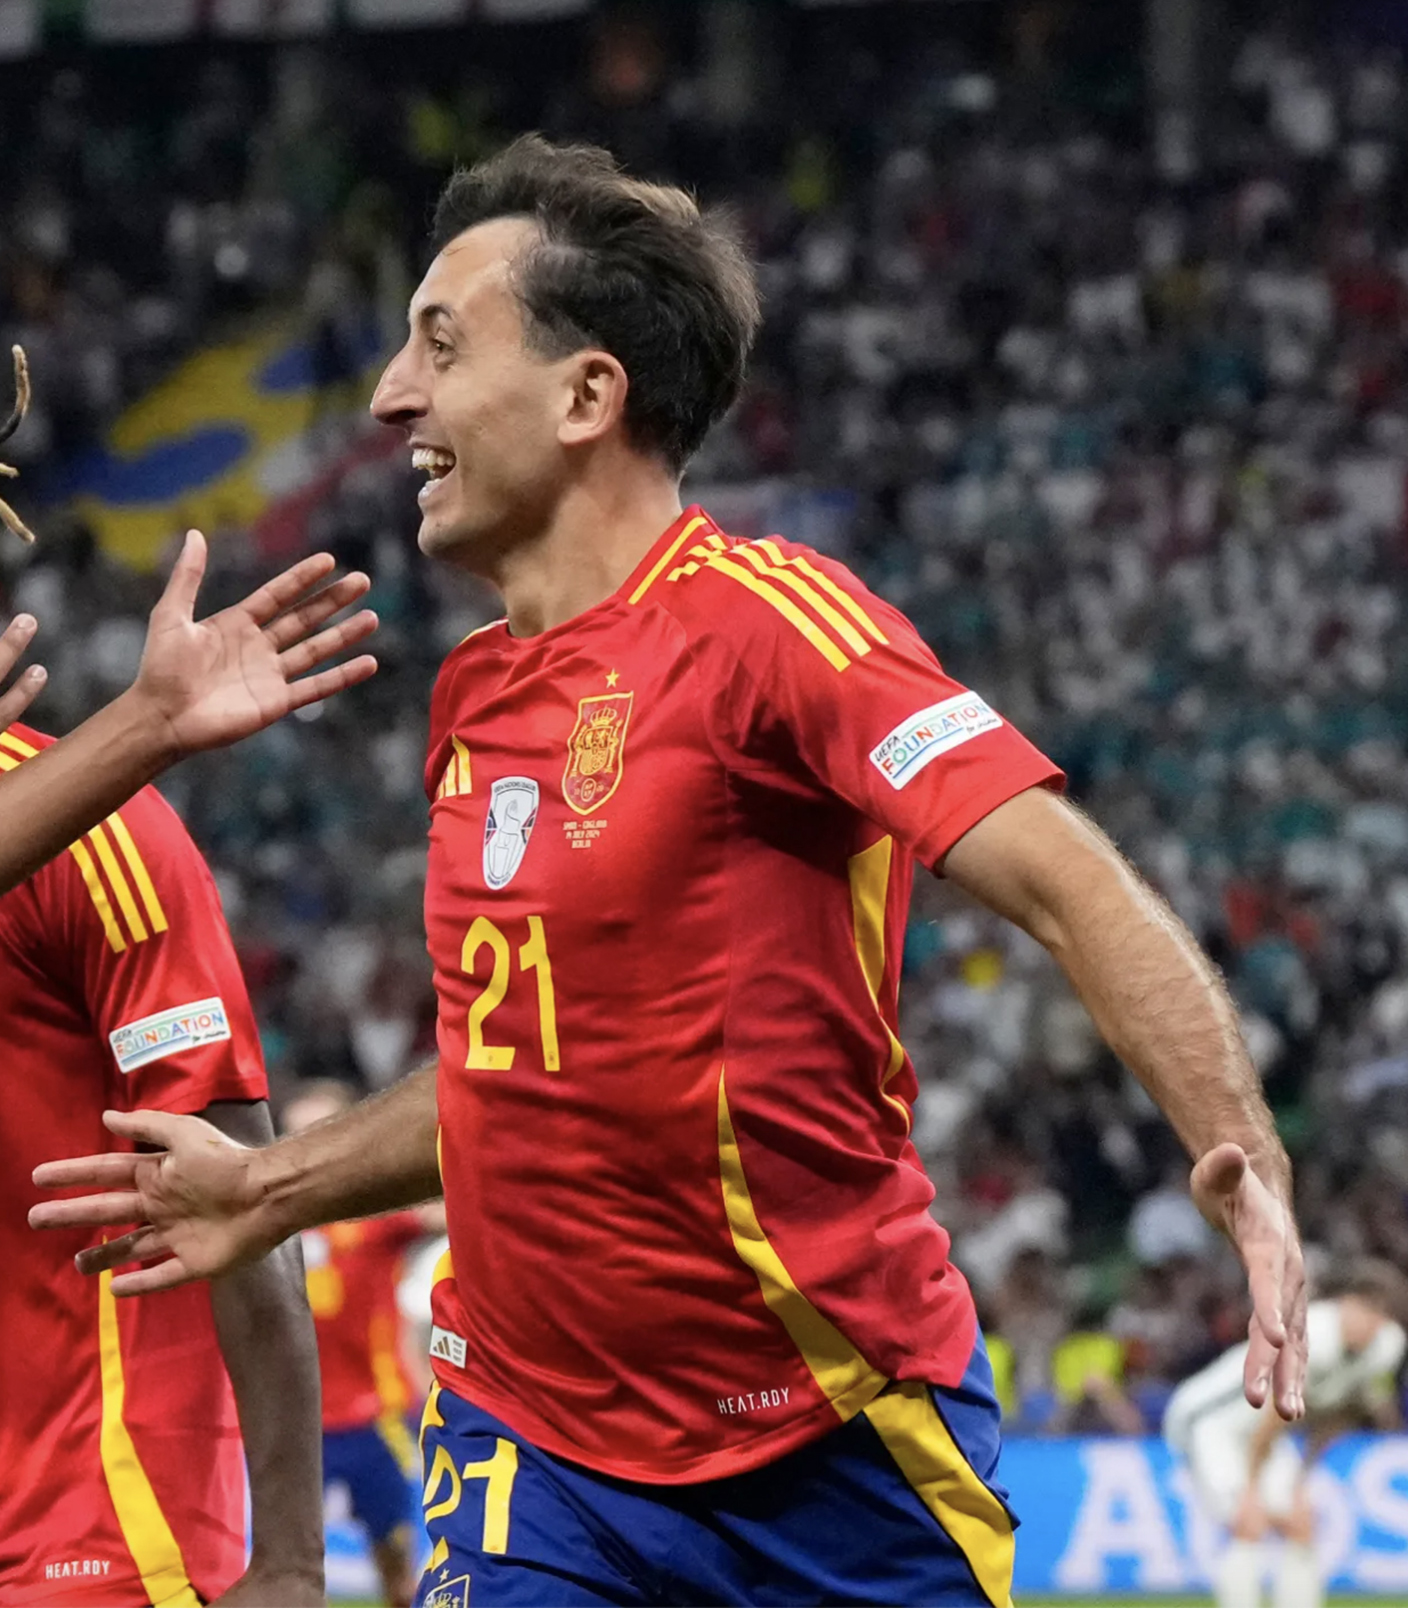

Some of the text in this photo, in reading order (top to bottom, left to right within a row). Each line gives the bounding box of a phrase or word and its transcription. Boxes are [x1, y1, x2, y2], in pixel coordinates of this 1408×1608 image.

[874, 735, 900, 761] UEFA
[881, 703, 990, 775] FOUNDATION
[461, 915, 561, 1072] 21
[115, 1010, 225, 1057] FOUNDATION
[717, 1387, 789, 1414] HEAT.RDY
[45, 1560, 110, 1580] HEAT.RDY
